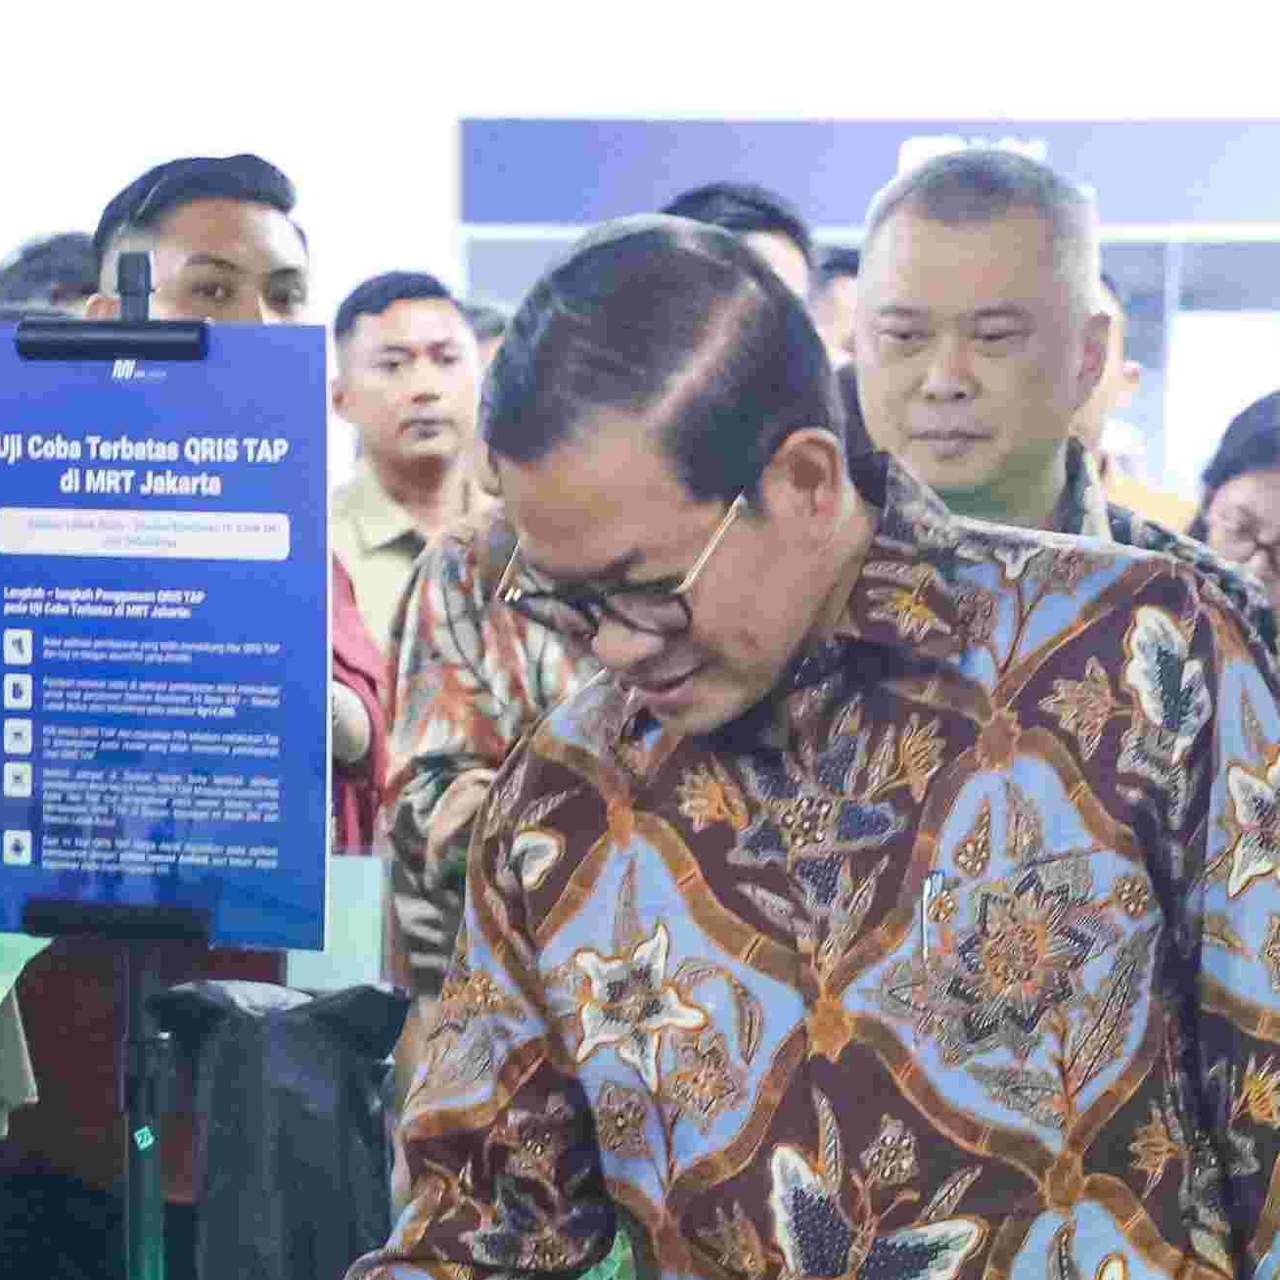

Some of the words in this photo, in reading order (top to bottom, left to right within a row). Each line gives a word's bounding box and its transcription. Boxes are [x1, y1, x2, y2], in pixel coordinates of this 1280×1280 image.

[27, 434, 81, 460] Coba
[85, 435, 179, 461] Terbatas
[183, 437, 239, 465] QRIS
[242, 438, 288, 463] TAP
[60, 467, 80, 493] di
[85, 469, 135, 494] MRT
[140, 469, 222, 495] Jakarta
